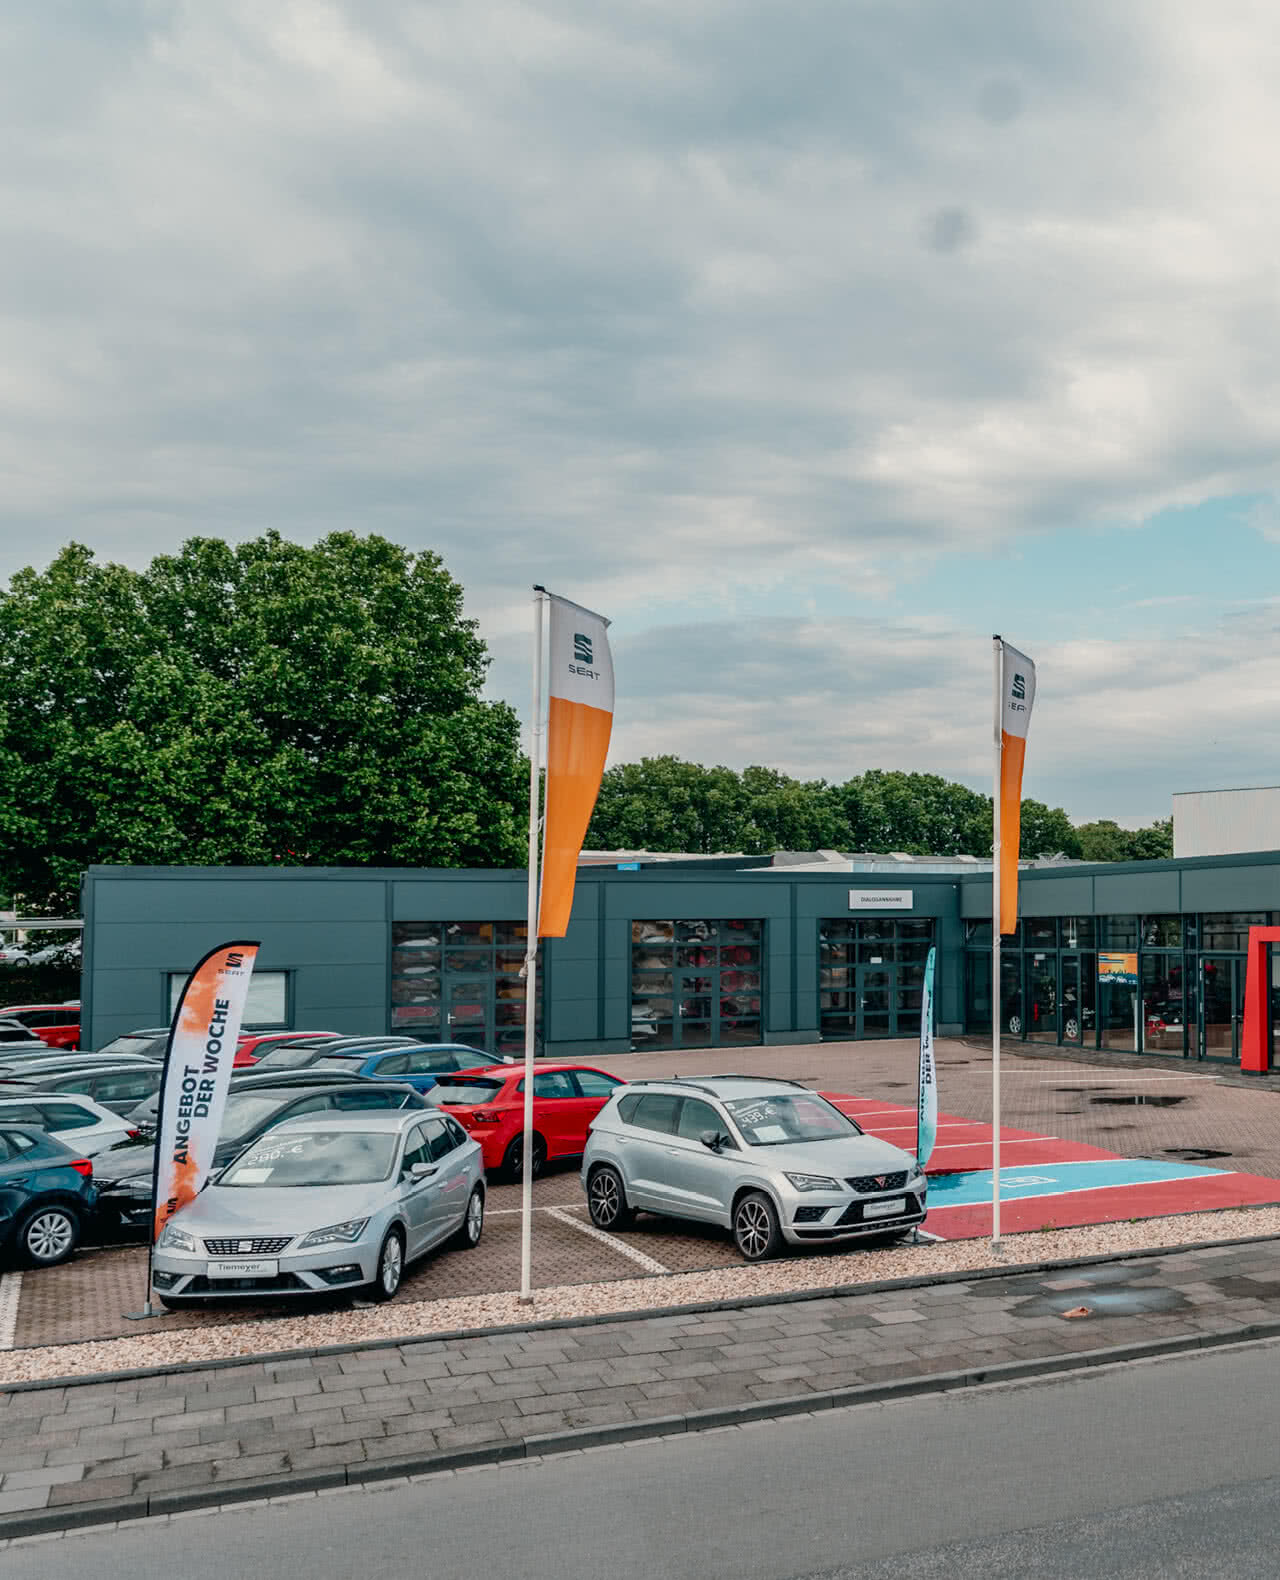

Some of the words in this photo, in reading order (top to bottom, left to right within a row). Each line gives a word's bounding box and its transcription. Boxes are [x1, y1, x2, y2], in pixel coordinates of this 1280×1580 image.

[569, 664, 600, 680] SEAT
[202, 999, 229, 1074] WOCHE
[173, 1065, 200, 1165] ANGEBOT
[194, 1079, 216, 1118] DER
[218, 1264, 260, 1273] Tiemeyer
